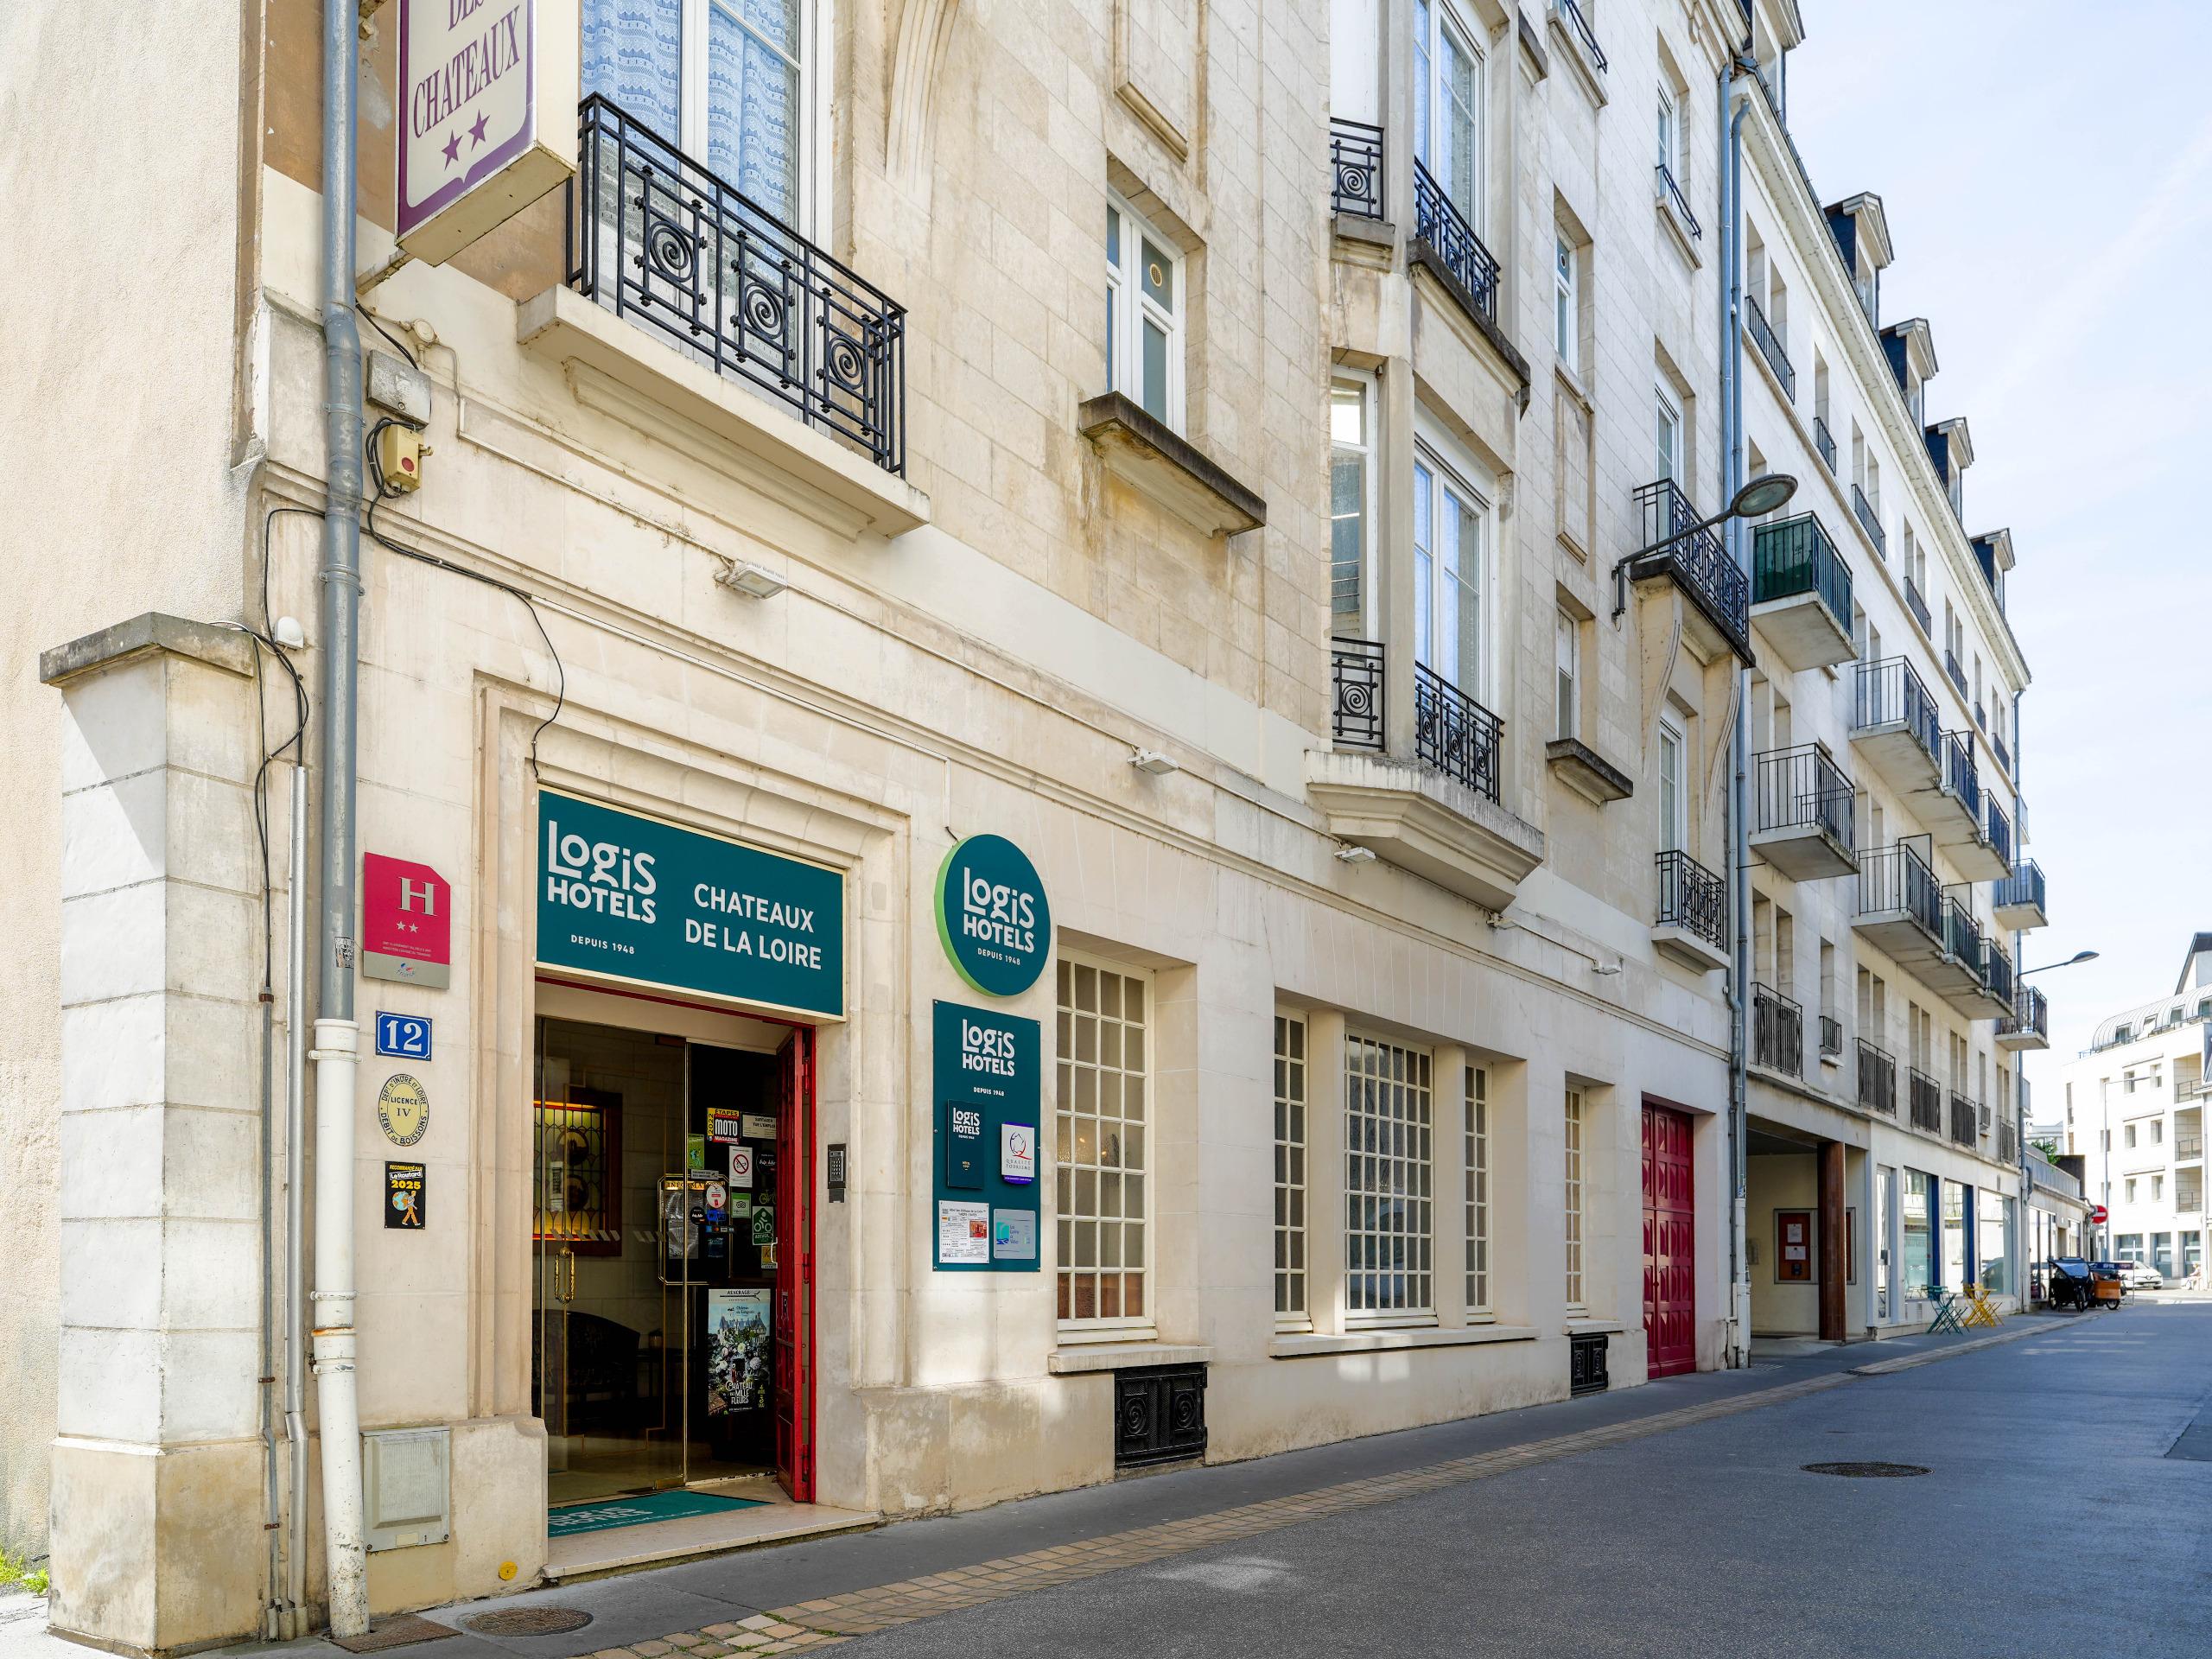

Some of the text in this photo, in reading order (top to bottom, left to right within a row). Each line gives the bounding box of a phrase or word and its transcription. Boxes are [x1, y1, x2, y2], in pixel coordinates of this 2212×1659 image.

[413, 5, 520, 139] CHATEAUX
[397, 876, 439, 917] H
[547, 876, 657, 925] HOTELS
[694, 883, 814, 933] CHATEAUX
[570, 934, 635, 955] DEPUIS 1948
[685, 918, 822, 970] DE LA LOIRE
[963, 914, 1035, 953] HOTELS
[977, 948, 1020, 965] DEPUIS 1948
[386, 1020, 423, 1052] 12
[962, 1052, 1015, 1077] HOTELS
[391, 1096, 417, 1105] LICENCE
[416, 1087, 427, 1104] LOIRE
[397, 1108, 411, 1117] IV
[399, 1116, 427, 1144] BOISSONS
[715, 1118, 738, 1136] MOTO
[953, 1124, 980, 1135] HOTELS
[391, 1179, 422, 1190] 2025
